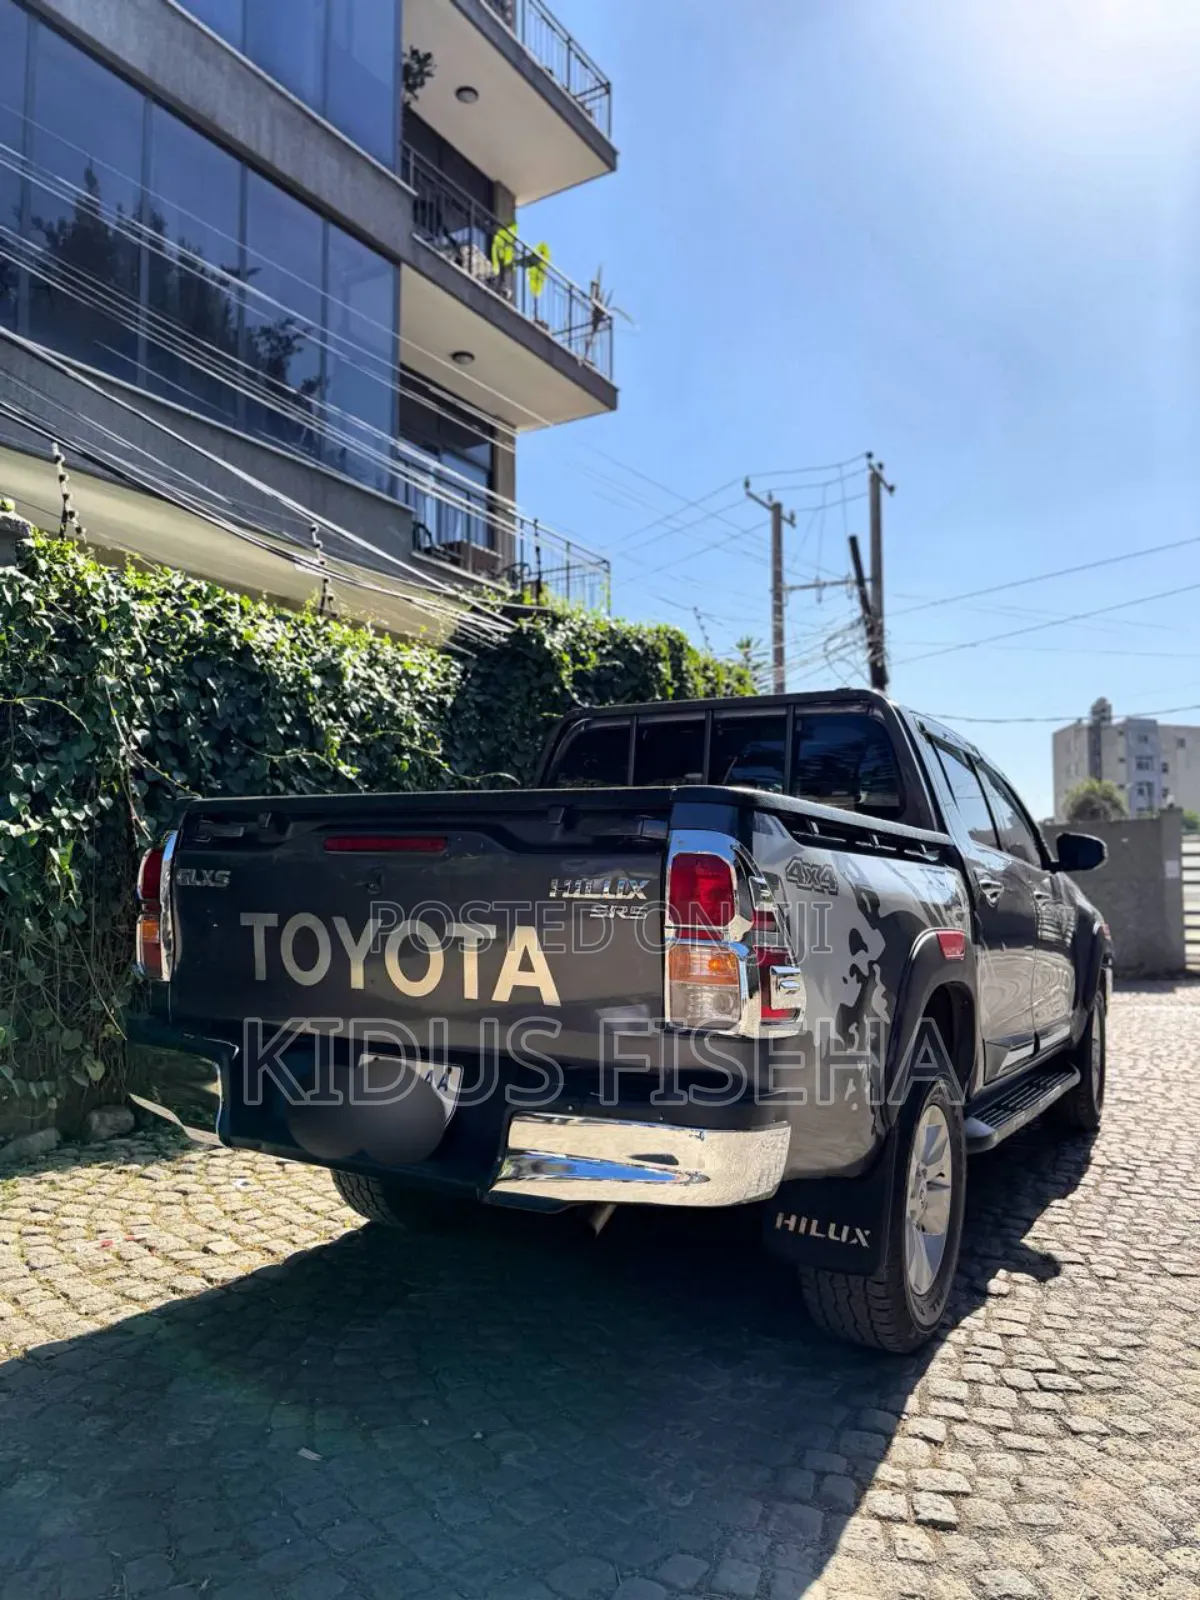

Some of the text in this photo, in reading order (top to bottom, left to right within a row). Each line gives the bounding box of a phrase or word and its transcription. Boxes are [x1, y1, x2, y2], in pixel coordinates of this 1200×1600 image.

[549, 878, 650, 900] HILUX
[239, 911, 562, 1007] TOYOTA
[775, 1211, 871, 1249] HILUX
